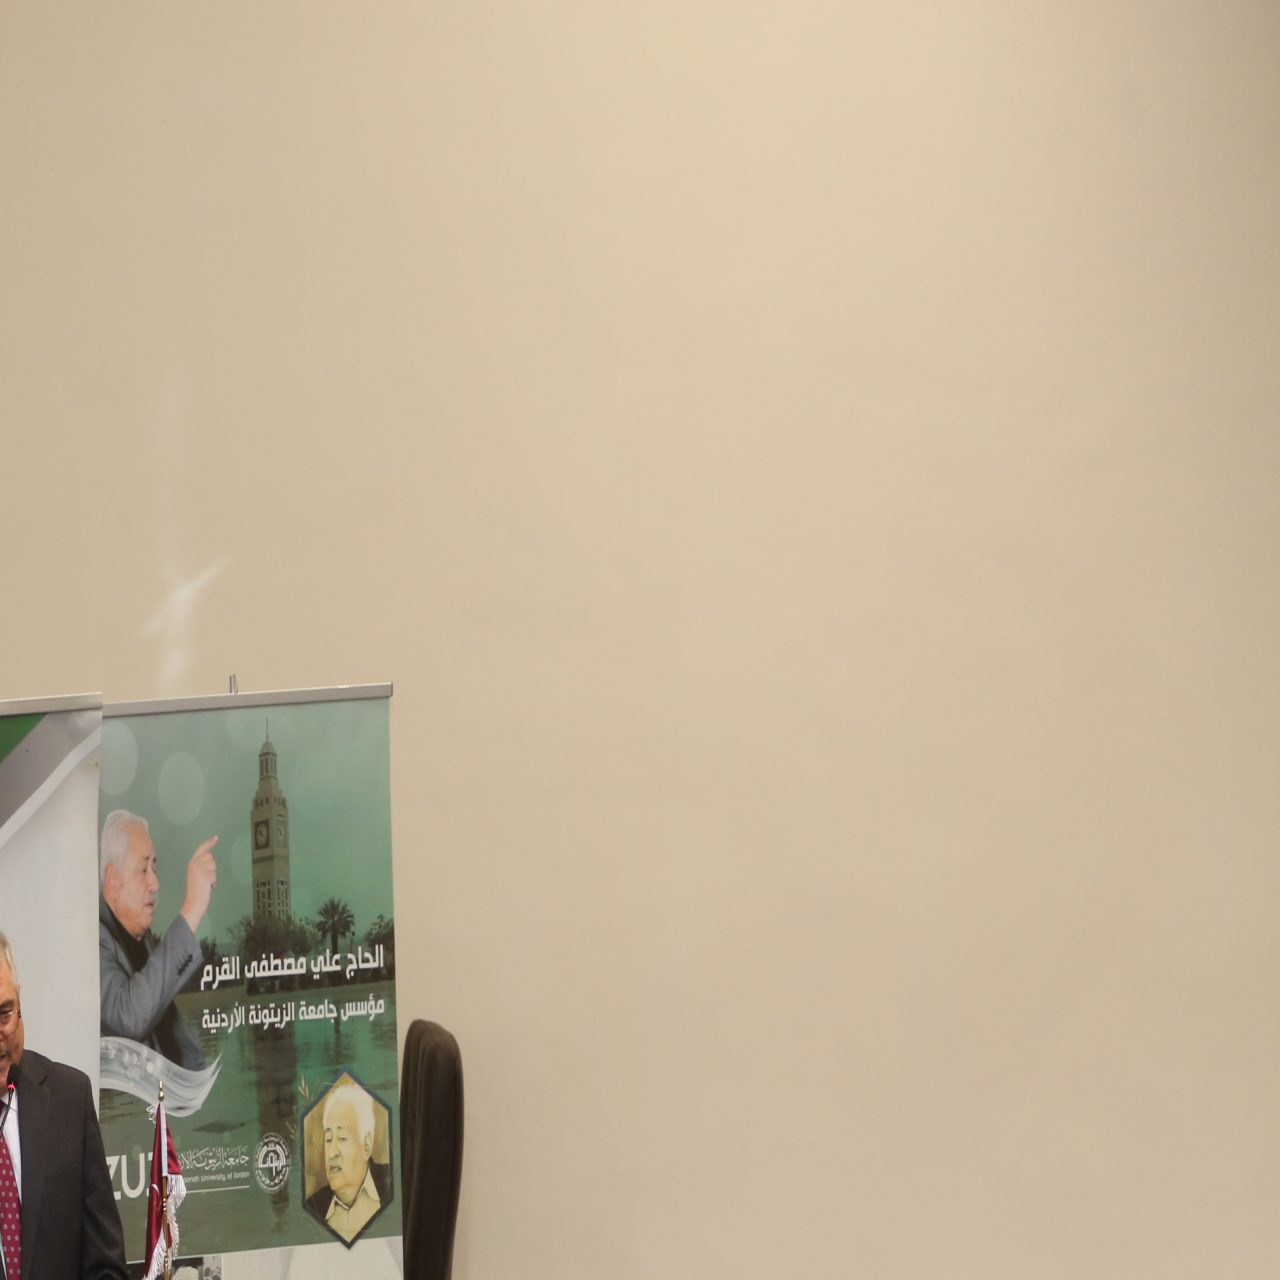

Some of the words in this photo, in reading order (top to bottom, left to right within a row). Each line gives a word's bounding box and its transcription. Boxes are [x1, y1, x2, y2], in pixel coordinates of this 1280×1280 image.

[200, 955, 240, 991] القرم
[244, 952, 306, 979] مصطفى
[311, 948, 341, 980] علي
[346, 944, 384, 979] الحاج
[202, 1002, 245, 1034] الأردنية
[248, 1002, 295, 1030] الزيتونة
[299, 999, 337, 1024] جامعة
[341, 993, 384, 1021] مؤسس
[106, 1152, 153, 1200] ZU
